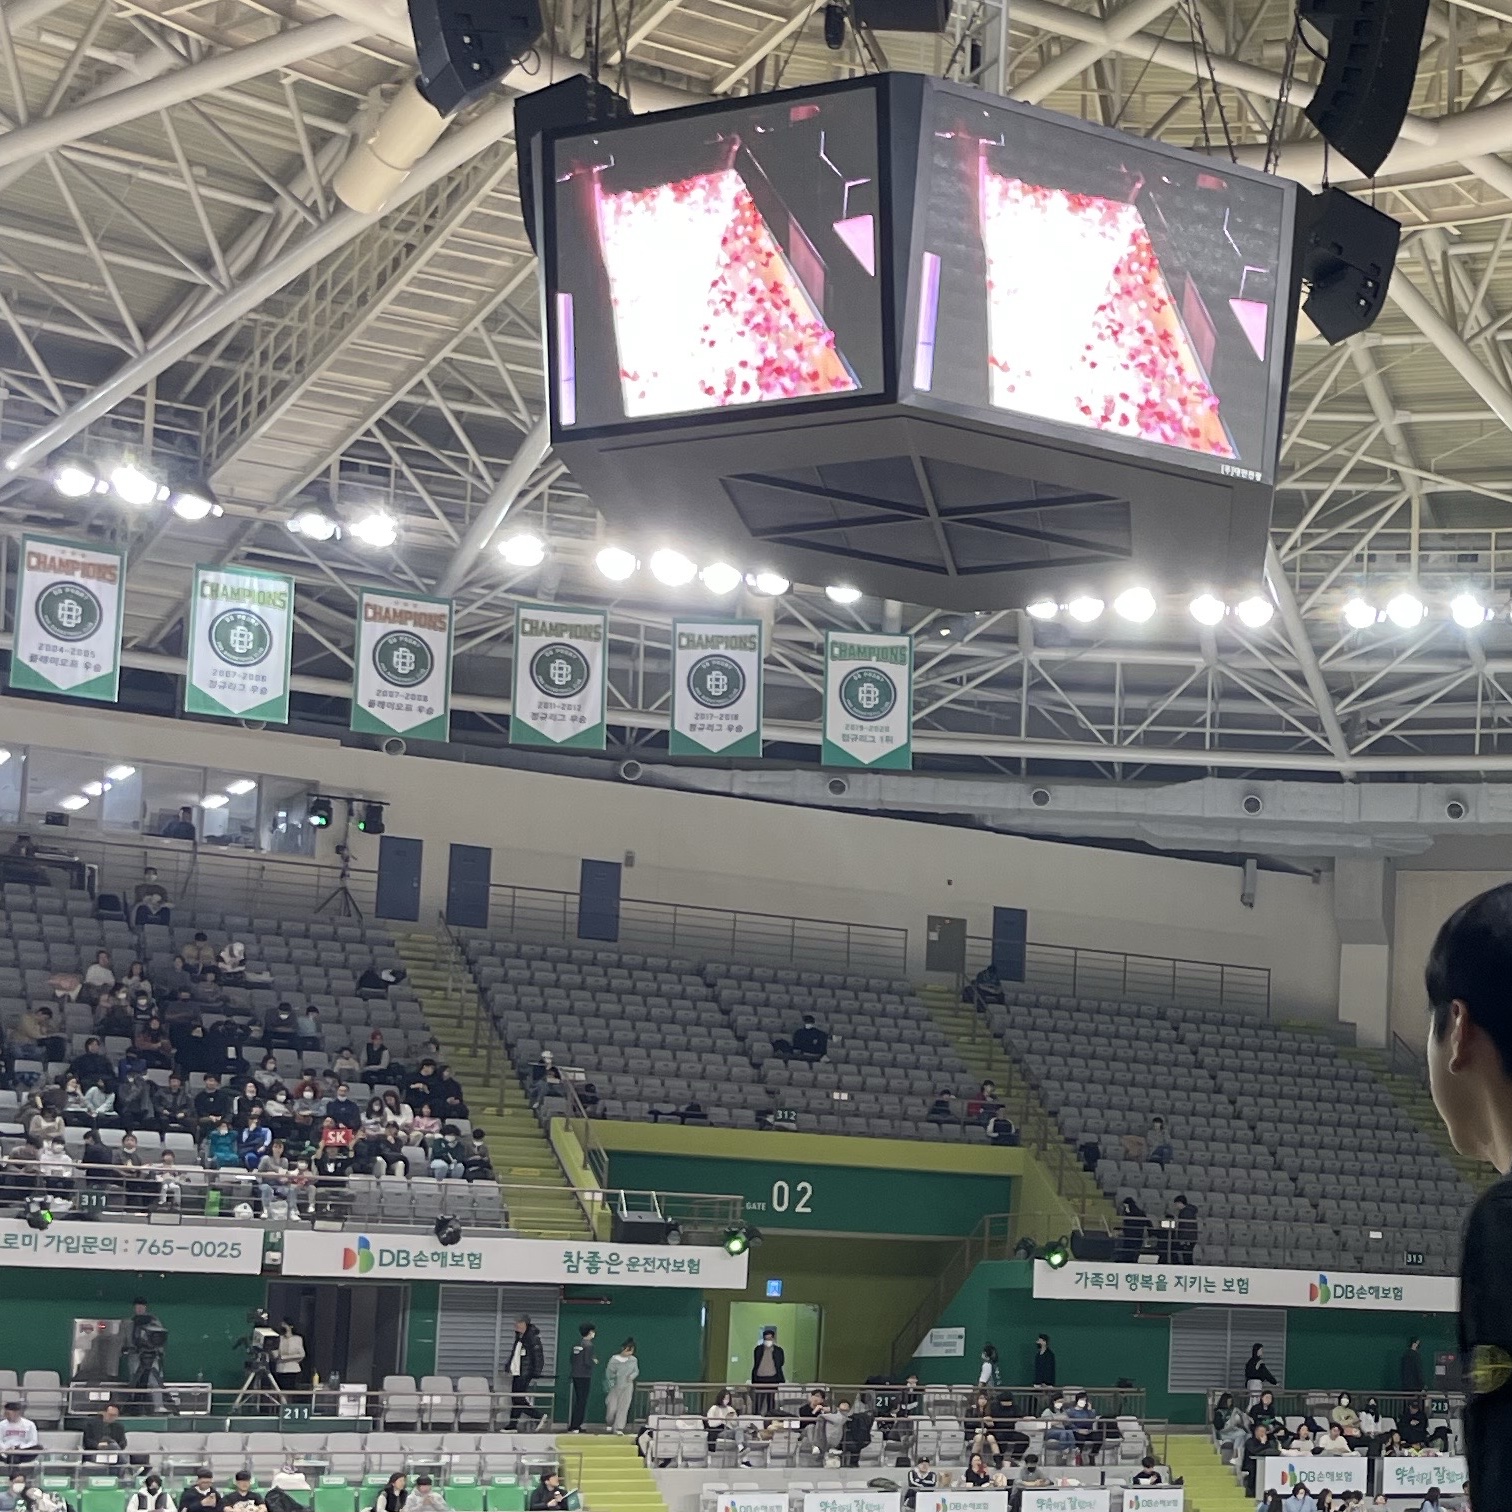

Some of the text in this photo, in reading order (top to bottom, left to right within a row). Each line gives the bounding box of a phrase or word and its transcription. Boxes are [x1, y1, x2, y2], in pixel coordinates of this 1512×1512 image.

[27, 551, 118, 585] CHAMPIONS
[201, 580, 287, 610] CHAMPIONS
[364, 602, 447, 632] CHAMPIONS
[521, 618, 602, 642] CHAMPIONS
[678, 632, 757, 652] CHAMPIONS
[830, 640, 908, 666] CHAMPIONS
[777, 1110, 796, 1121] 312
[81, 1194, 107, 1206] 311
[746, 1180, 813, 1213] GATE 02
[45, 1234, 117, 1255] 가입문의
[136, 1238, 242, 1259] 765-0025
[379, 1248, 482, 1270] DB손해보험
[562, 1251, 701, 1275] 참좋은 운전자보험
[1406, 1254, 1424, 1264] 313
[1075, 1271, 1250, 1295] 가족의 행복을 지키는 보험
[1333, 1284, 1403, 1301] DB손해보험
[284, 1408, 309, 1420] 211
[1431, 1402, 1448, 1412] 213
[1301, 1470, 1353, 1483] DB손해보험
